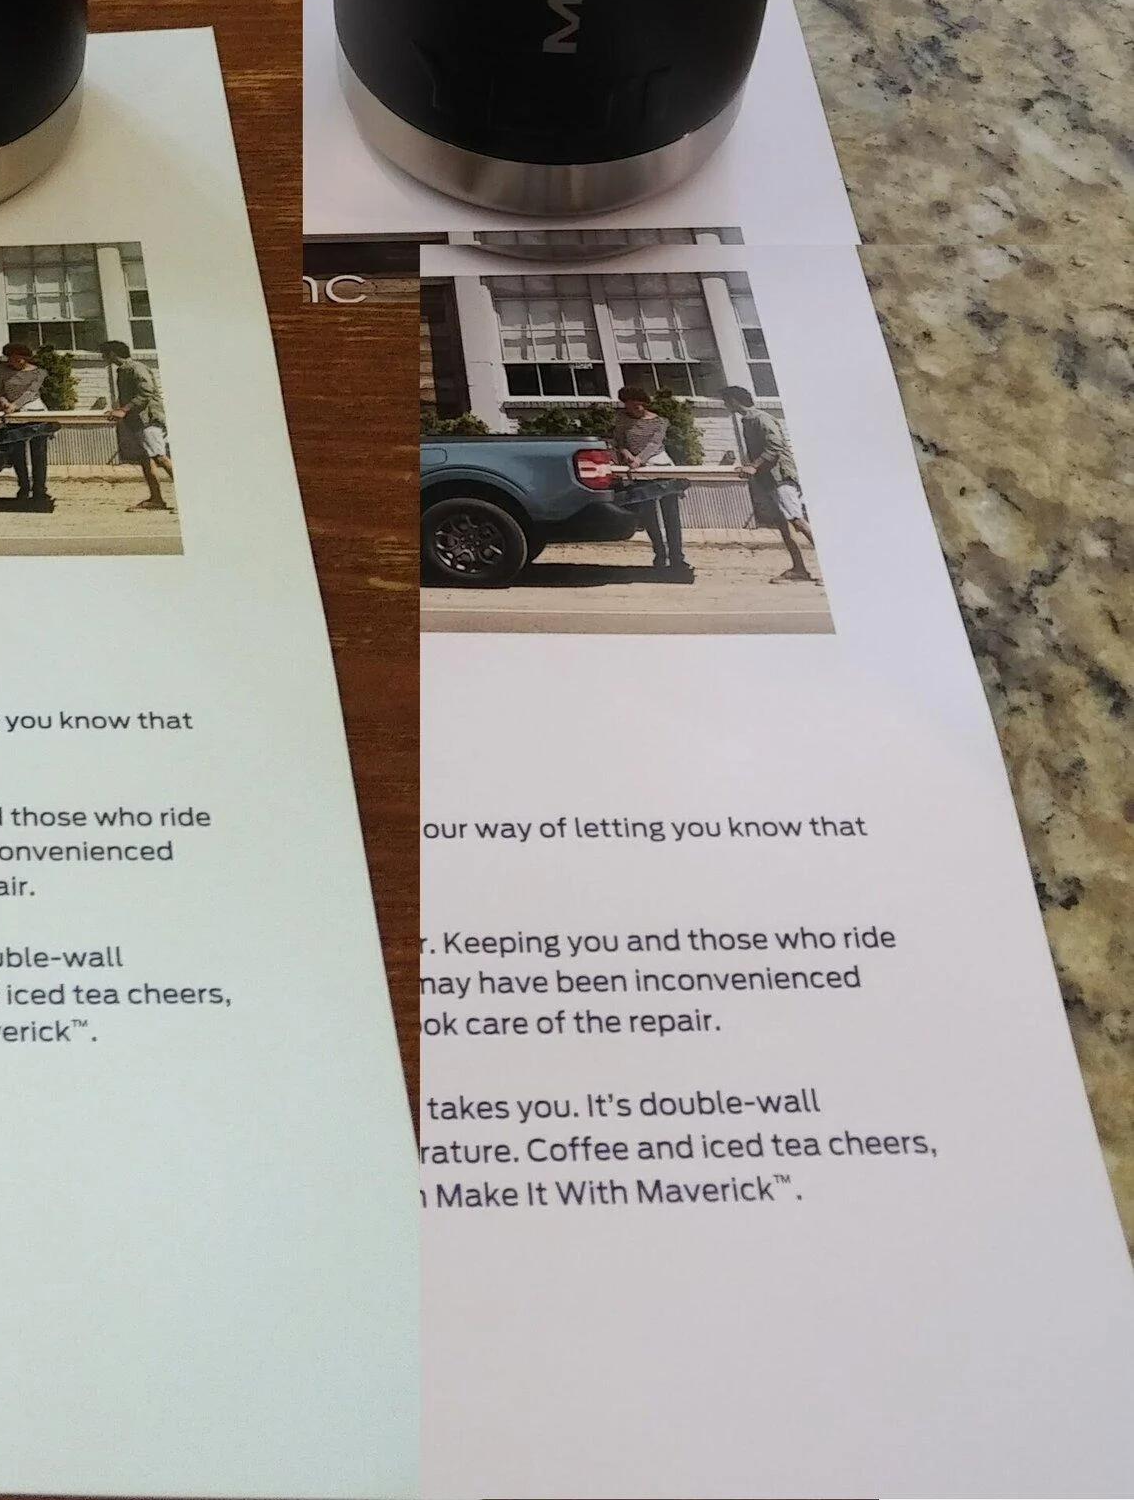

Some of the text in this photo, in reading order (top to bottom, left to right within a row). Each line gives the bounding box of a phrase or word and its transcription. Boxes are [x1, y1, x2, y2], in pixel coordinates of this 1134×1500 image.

[4, 714, 53, 733] you
[58, 710, 132, 730] know
[136, 710, 194, 731] that
[9, 806, 88, 828] those
[92, 806, 154, 828] who
[159, 806, 212, 828] ride
[423, 815, 869, 843] our way of letting you know that
[442, 930, 562, 959] Keeping
[566, 934, 619, 958] you
[626, 927, 682, 953] and
[686, 927, 769, 952] those
[773, 925, 837, 950] who
[842, 925, 897, 950] ride
[478, 964, 863, 995] have been inconvenienced
[6, 983, 66, 1006] iced
[71, 984, 121, 1006] tea
[126, 982, 232, 1008] cheers,
[525, 1129, 938, 1163] Coffee and iced tea cheers,
